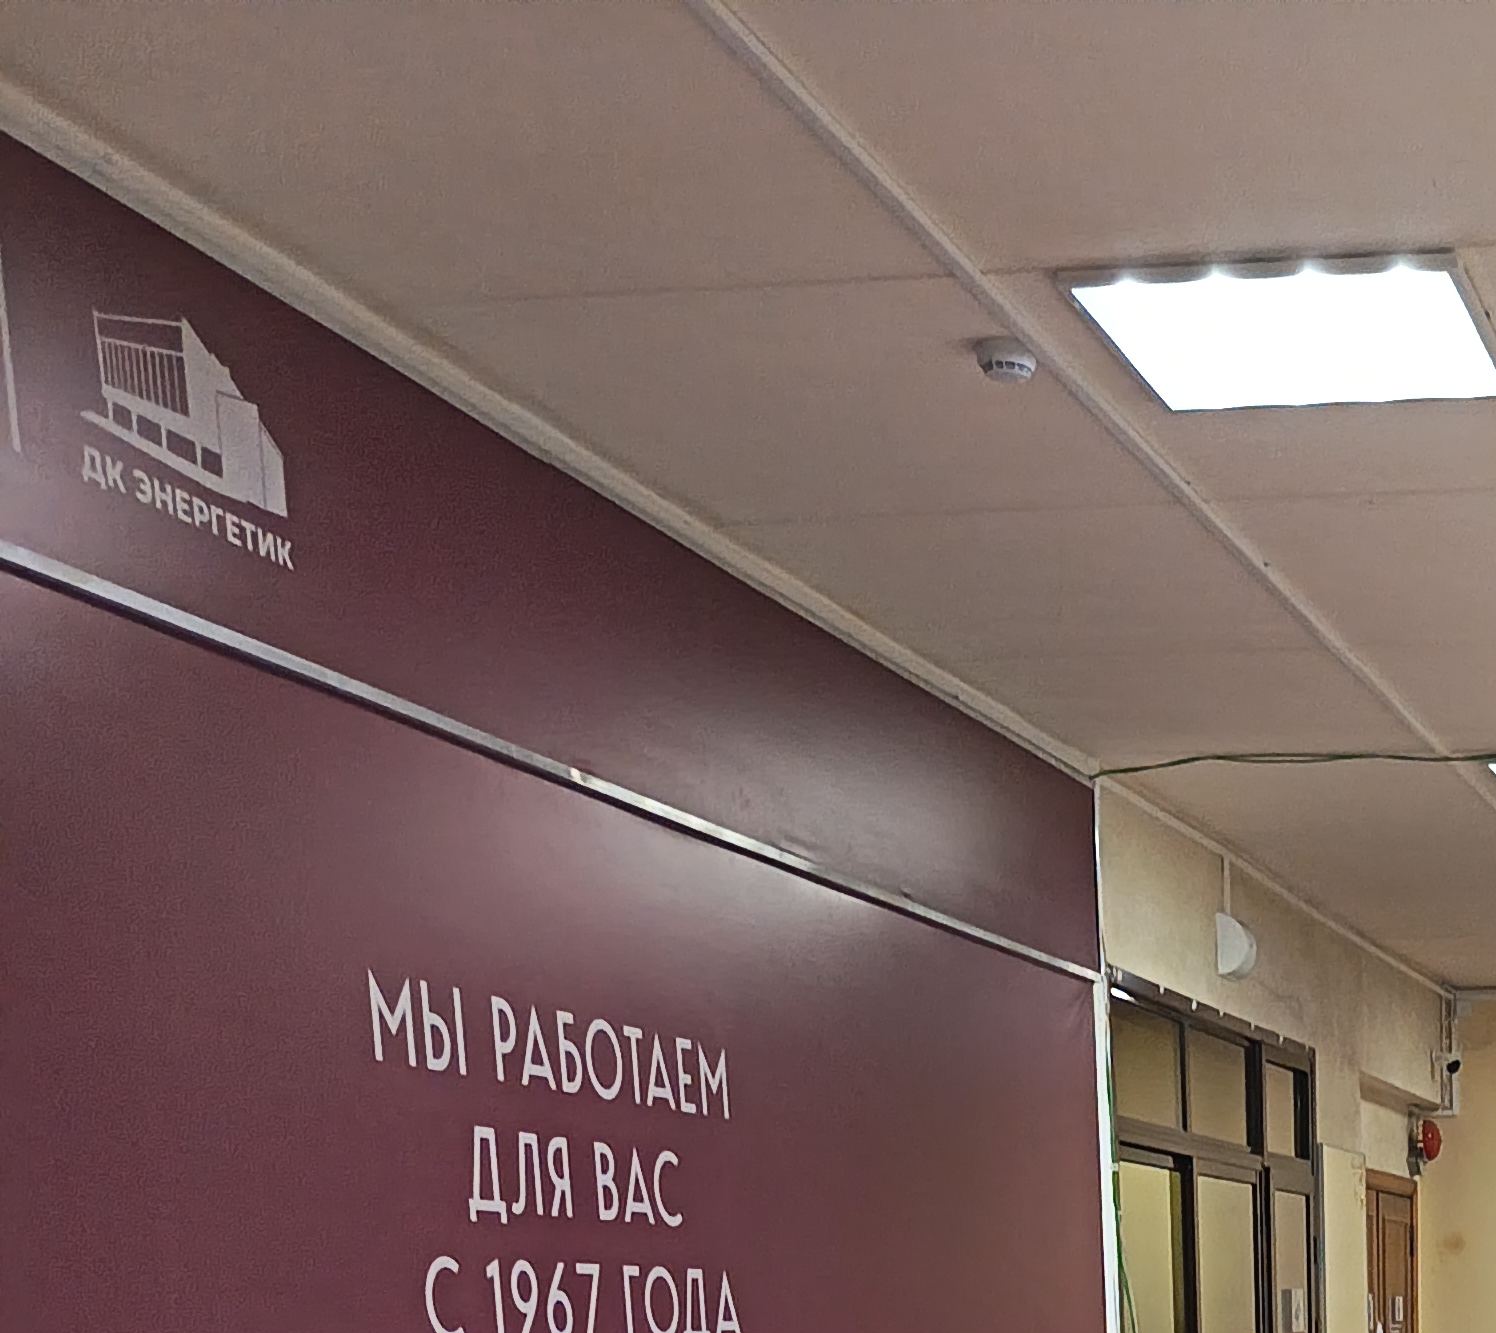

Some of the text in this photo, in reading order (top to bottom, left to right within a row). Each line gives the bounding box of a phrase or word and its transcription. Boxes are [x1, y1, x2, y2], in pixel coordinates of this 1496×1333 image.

[81, 444, 294, 571] ДК ЭНЕРГЕТИК
[367, 967, 730, 1121] МЫ РАБОТАЕМ
[468, 1125, 684, 1228] ДЛЯ ВАС
